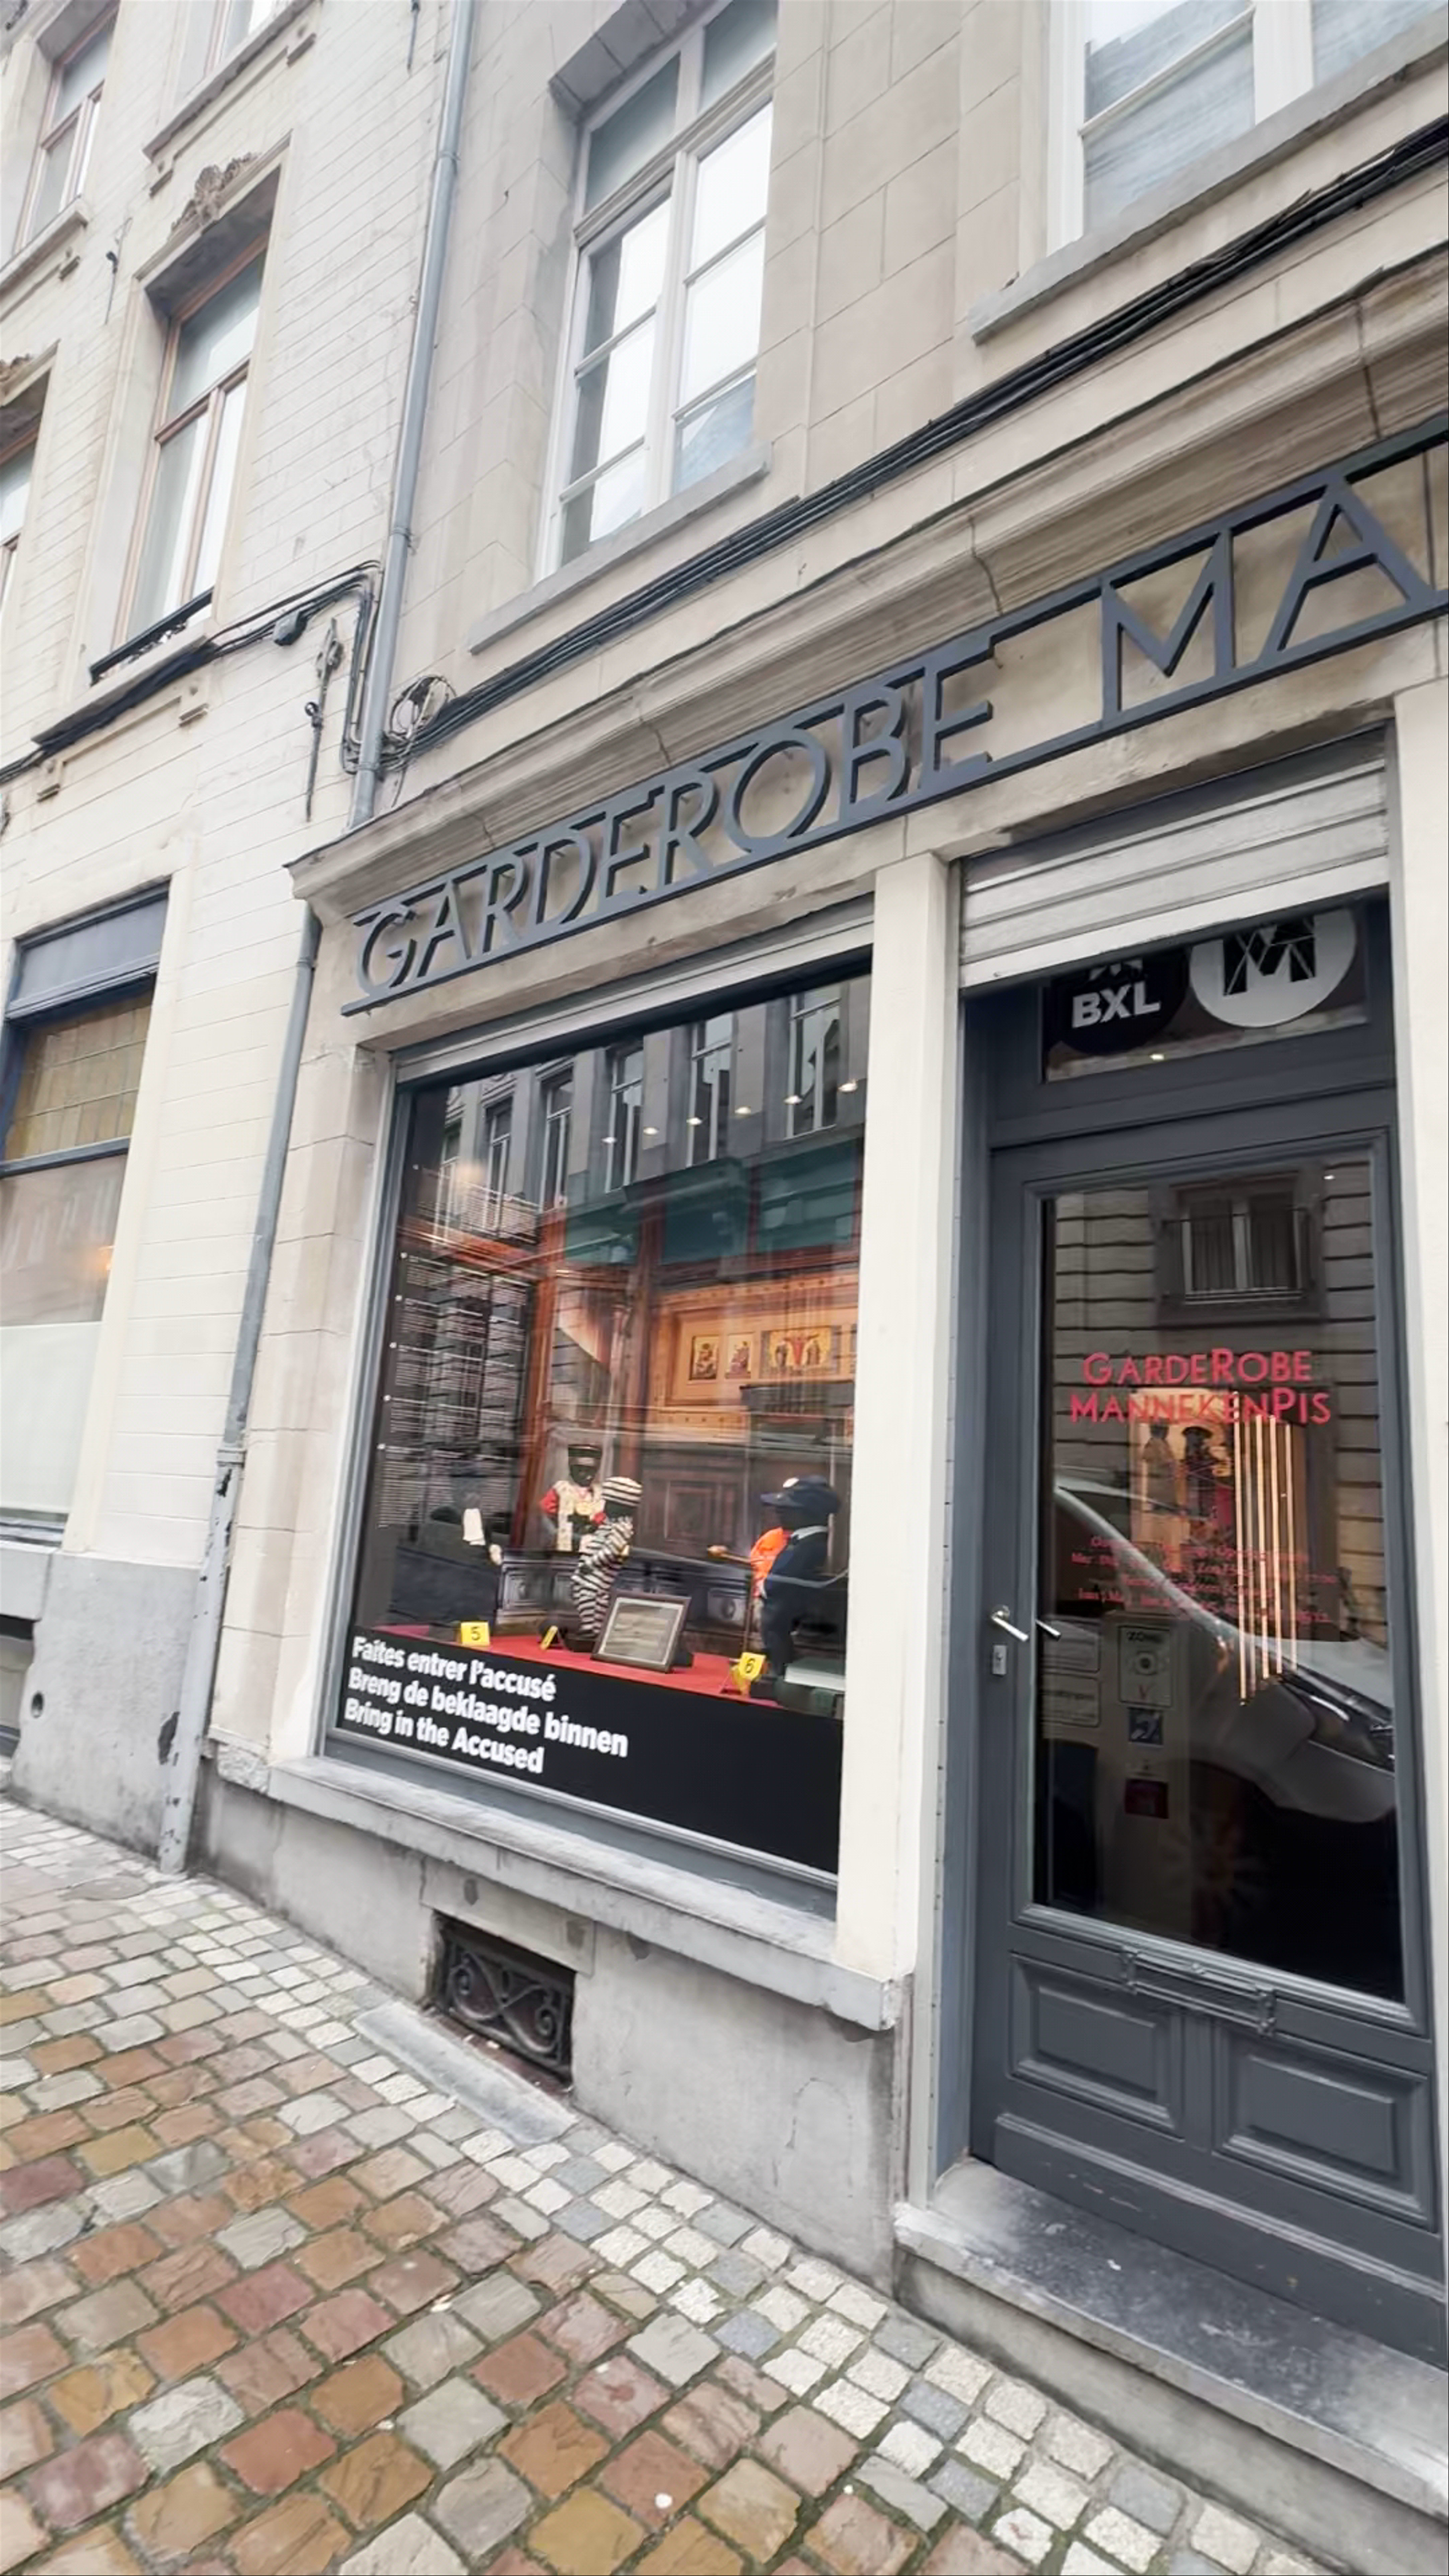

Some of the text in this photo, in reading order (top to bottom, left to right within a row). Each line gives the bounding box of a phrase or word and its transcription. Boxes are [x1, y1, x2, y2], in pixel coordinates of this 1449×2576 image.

[352, 638, 996, 998] GARDEROBE
[1072, 981, 1161, 1029] BXL
[470, 1626, 481, 1641] 5
[744, 1658, 755, 1674] 6
[352, 1636, 557, 1702] Faites entrer l'accusé
[344, 1698, 545, 1774] Bring in the Accused
[348, 1667, 628, 1758] Breng de beklaagde binnen
